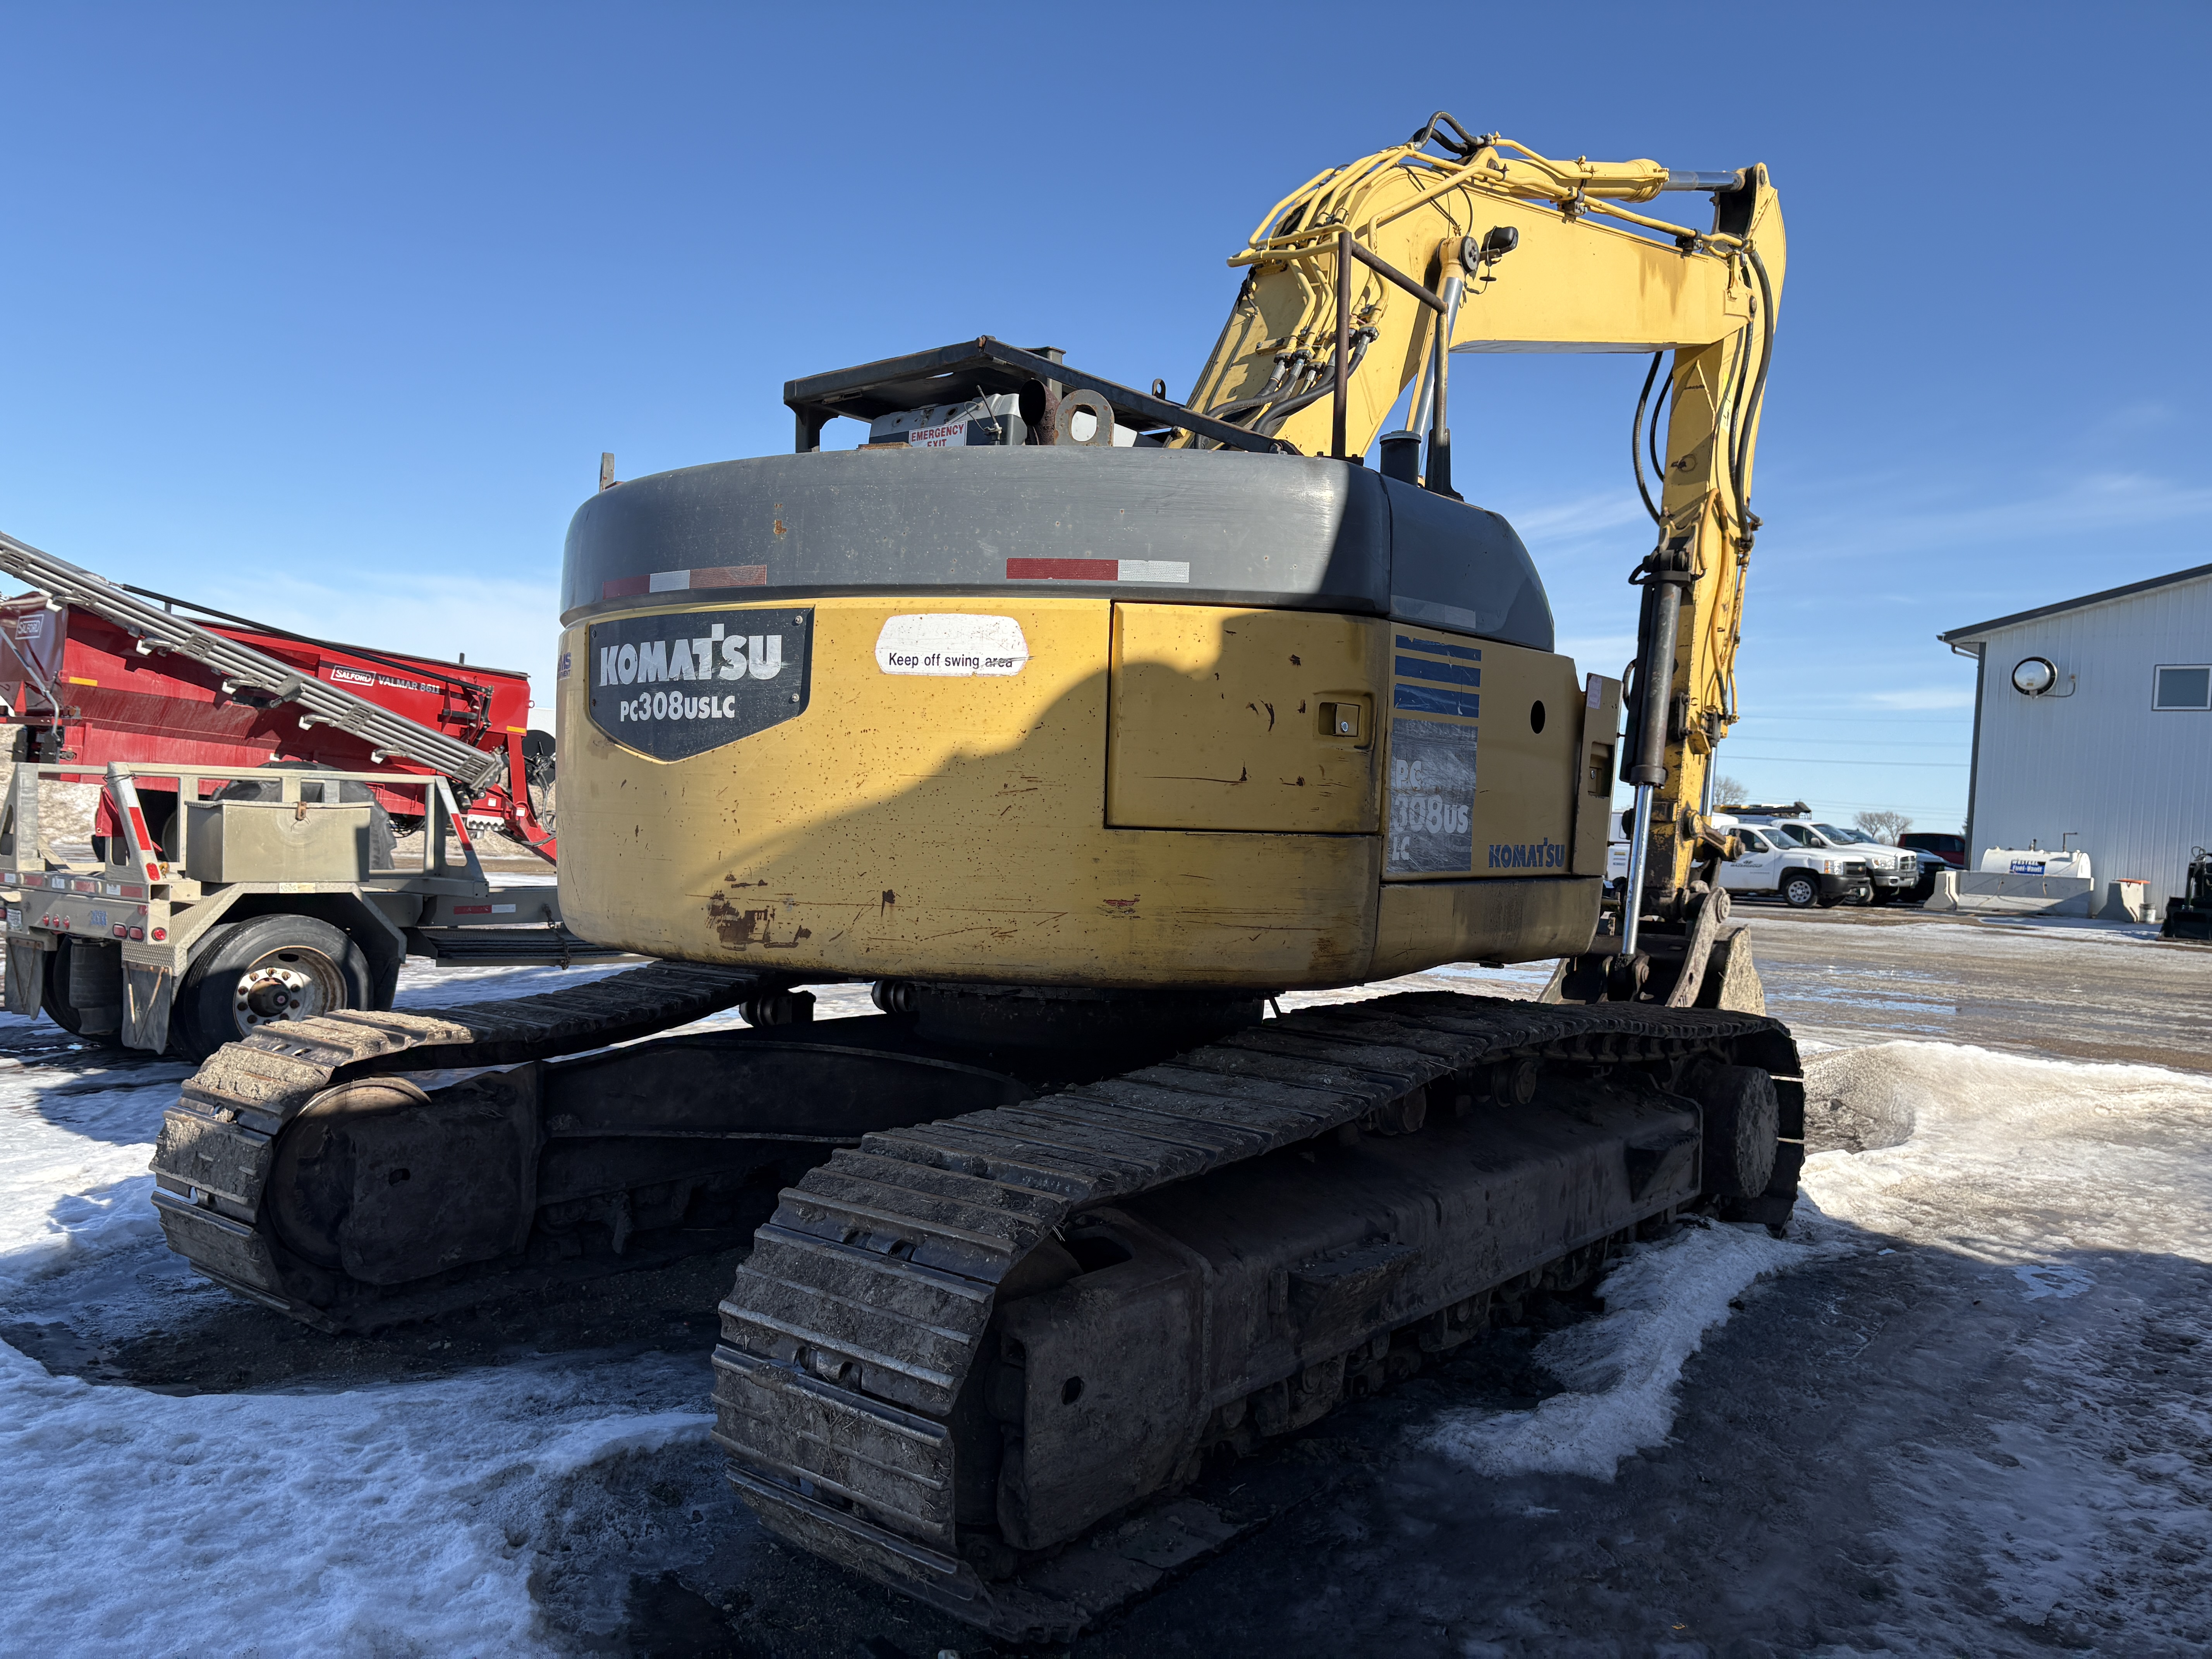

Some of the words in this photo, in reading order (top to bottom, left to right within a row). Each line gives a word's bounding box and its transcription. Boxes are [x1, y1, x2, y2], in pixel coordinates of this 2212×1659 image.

[911, 424, 964, 442] EMERGENCY
[927, 439, 947, 447] EXIT
[599, 623, 782, 687] KOMATSU
[889, 653, 919, 669] Keep
[924, 653, 941, 666] off
[945, 654, 979, 669] swing
[985, 657, 1013, 668] area
[335, 669, 372, 683] SALFORD
[378, 675, 417, 690] VALMAR
[420, 682, 440, 694] 8611
[620, 690, 735, 722] PC308USLC
[1396, 759, 1422, 791] PC
[1391, 836, 1410, 861] LC
[1489, 837, 1565, 868] KOMATSU
